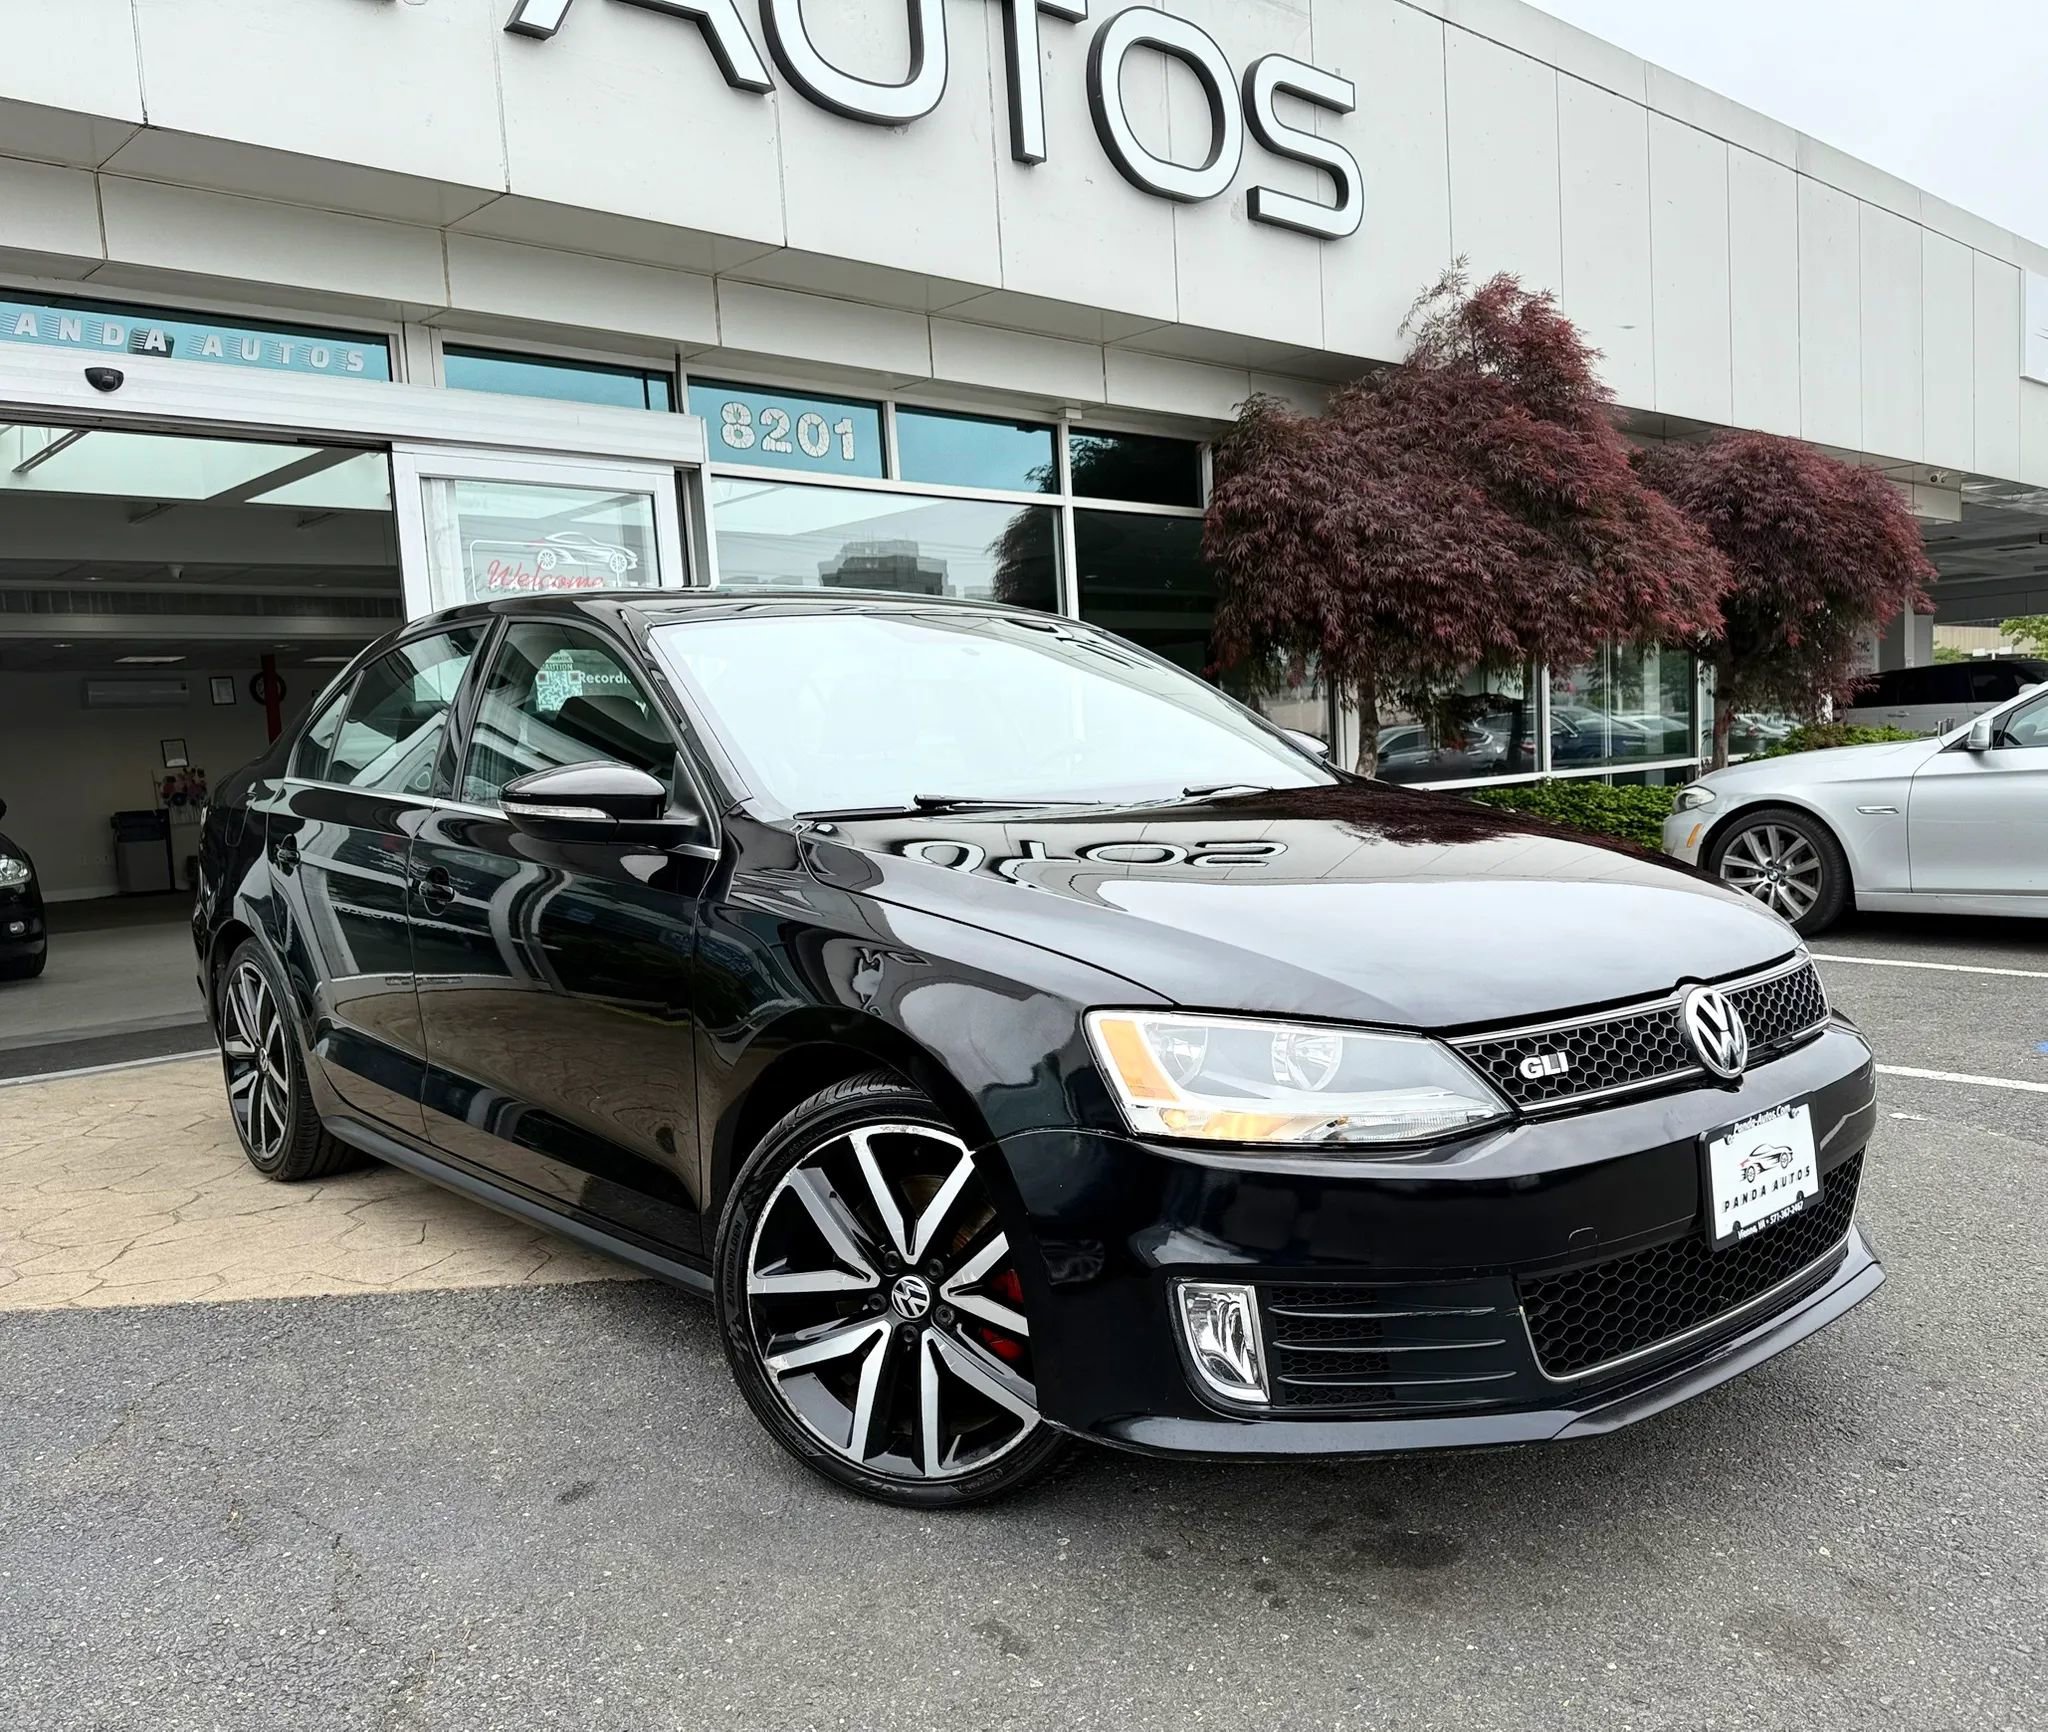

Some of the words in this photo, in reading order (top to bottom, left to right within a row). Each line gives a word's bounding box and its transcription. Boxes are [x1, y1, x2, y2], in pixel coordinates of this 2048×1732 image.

[192, 333, 366, 372] AUTOS
[720, 401, 856, 462] 8201
[579, 670, 632, 684] Recordi
[1518, 1051, 1570, 1080] GLI
[1723, 1185, 1767, 1214] PANDA
[1772, 1165, 1811, 1192] AUTOS
